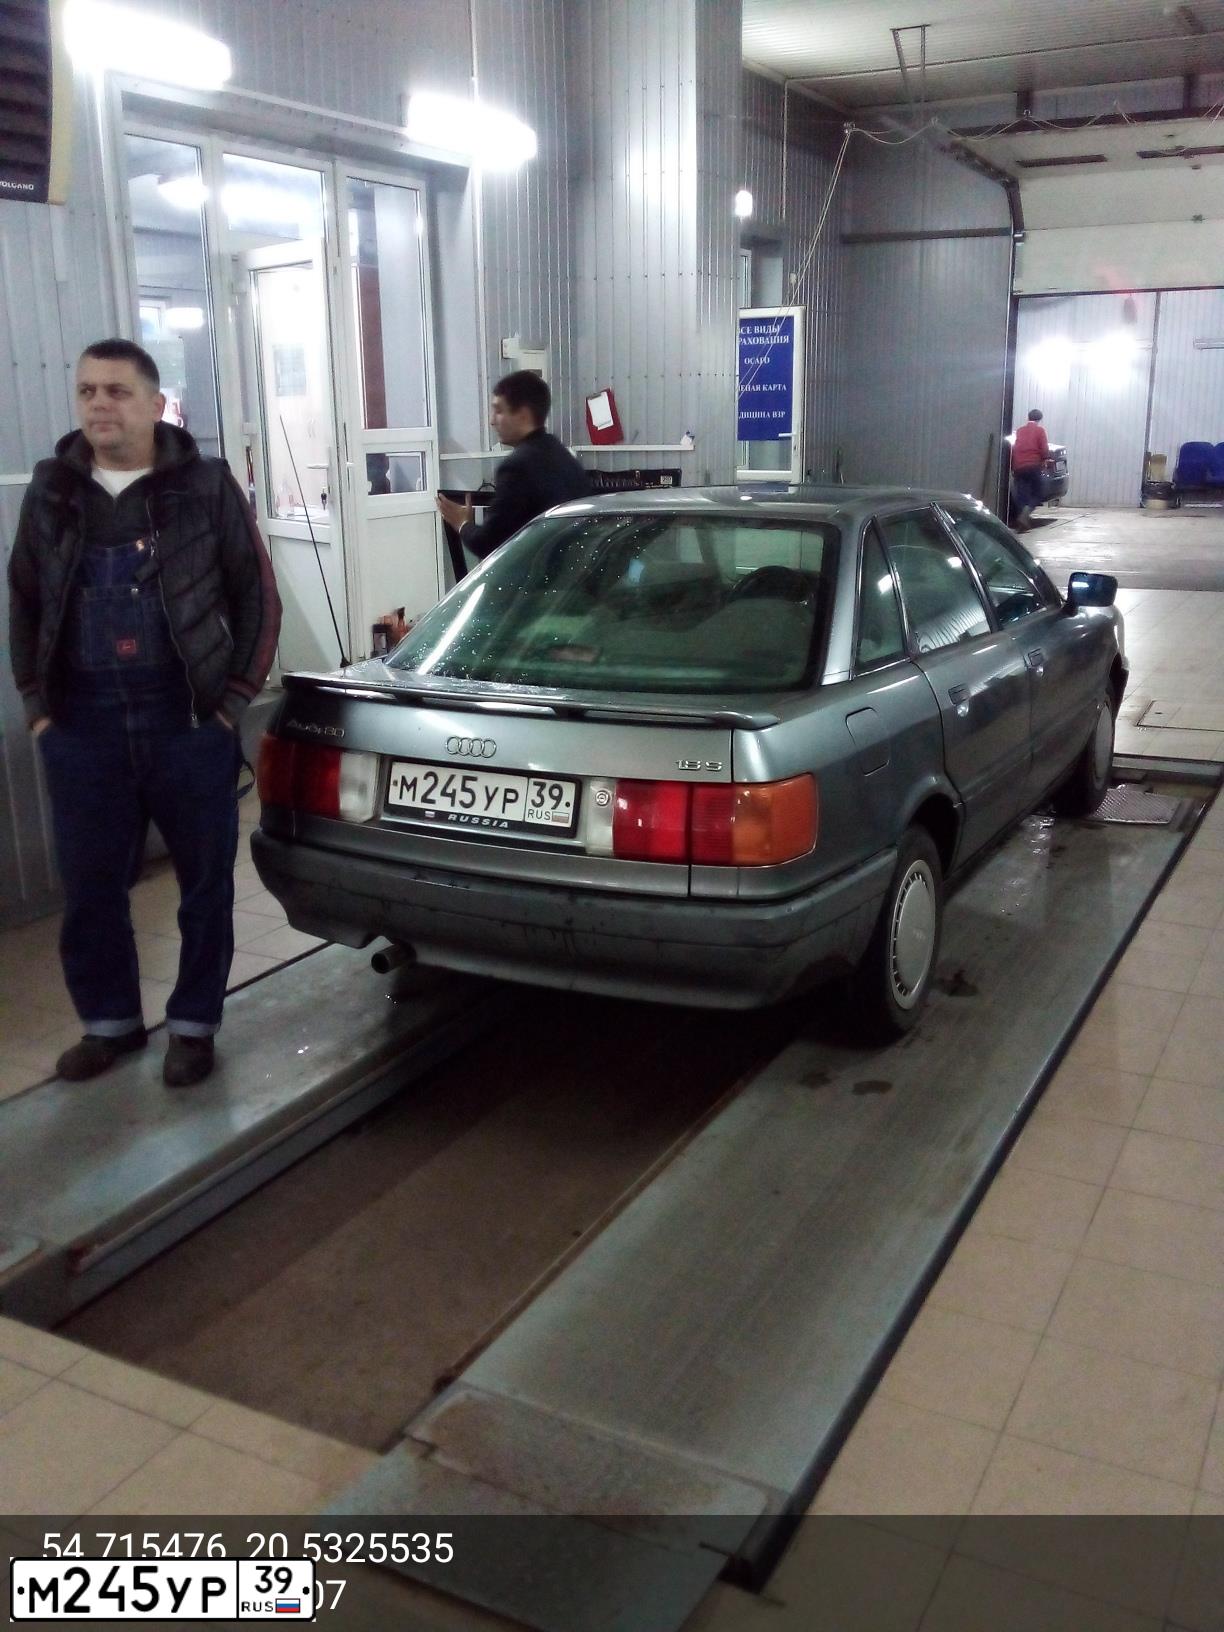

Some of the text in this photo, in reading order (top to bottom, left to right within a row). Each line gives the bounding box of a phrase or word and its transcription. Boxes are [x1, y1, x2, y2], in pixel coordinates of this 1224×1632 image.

[754, 325, 780, 334] ВИДЫ
[744, 357, 770, 365] ОСАГО
[762, 383, 787, 391] КАРТА
[531, 781, 564, 810] 39
[527, 808, 551, 821] RUS
[447, 813, 509, 829] RUSSIA
